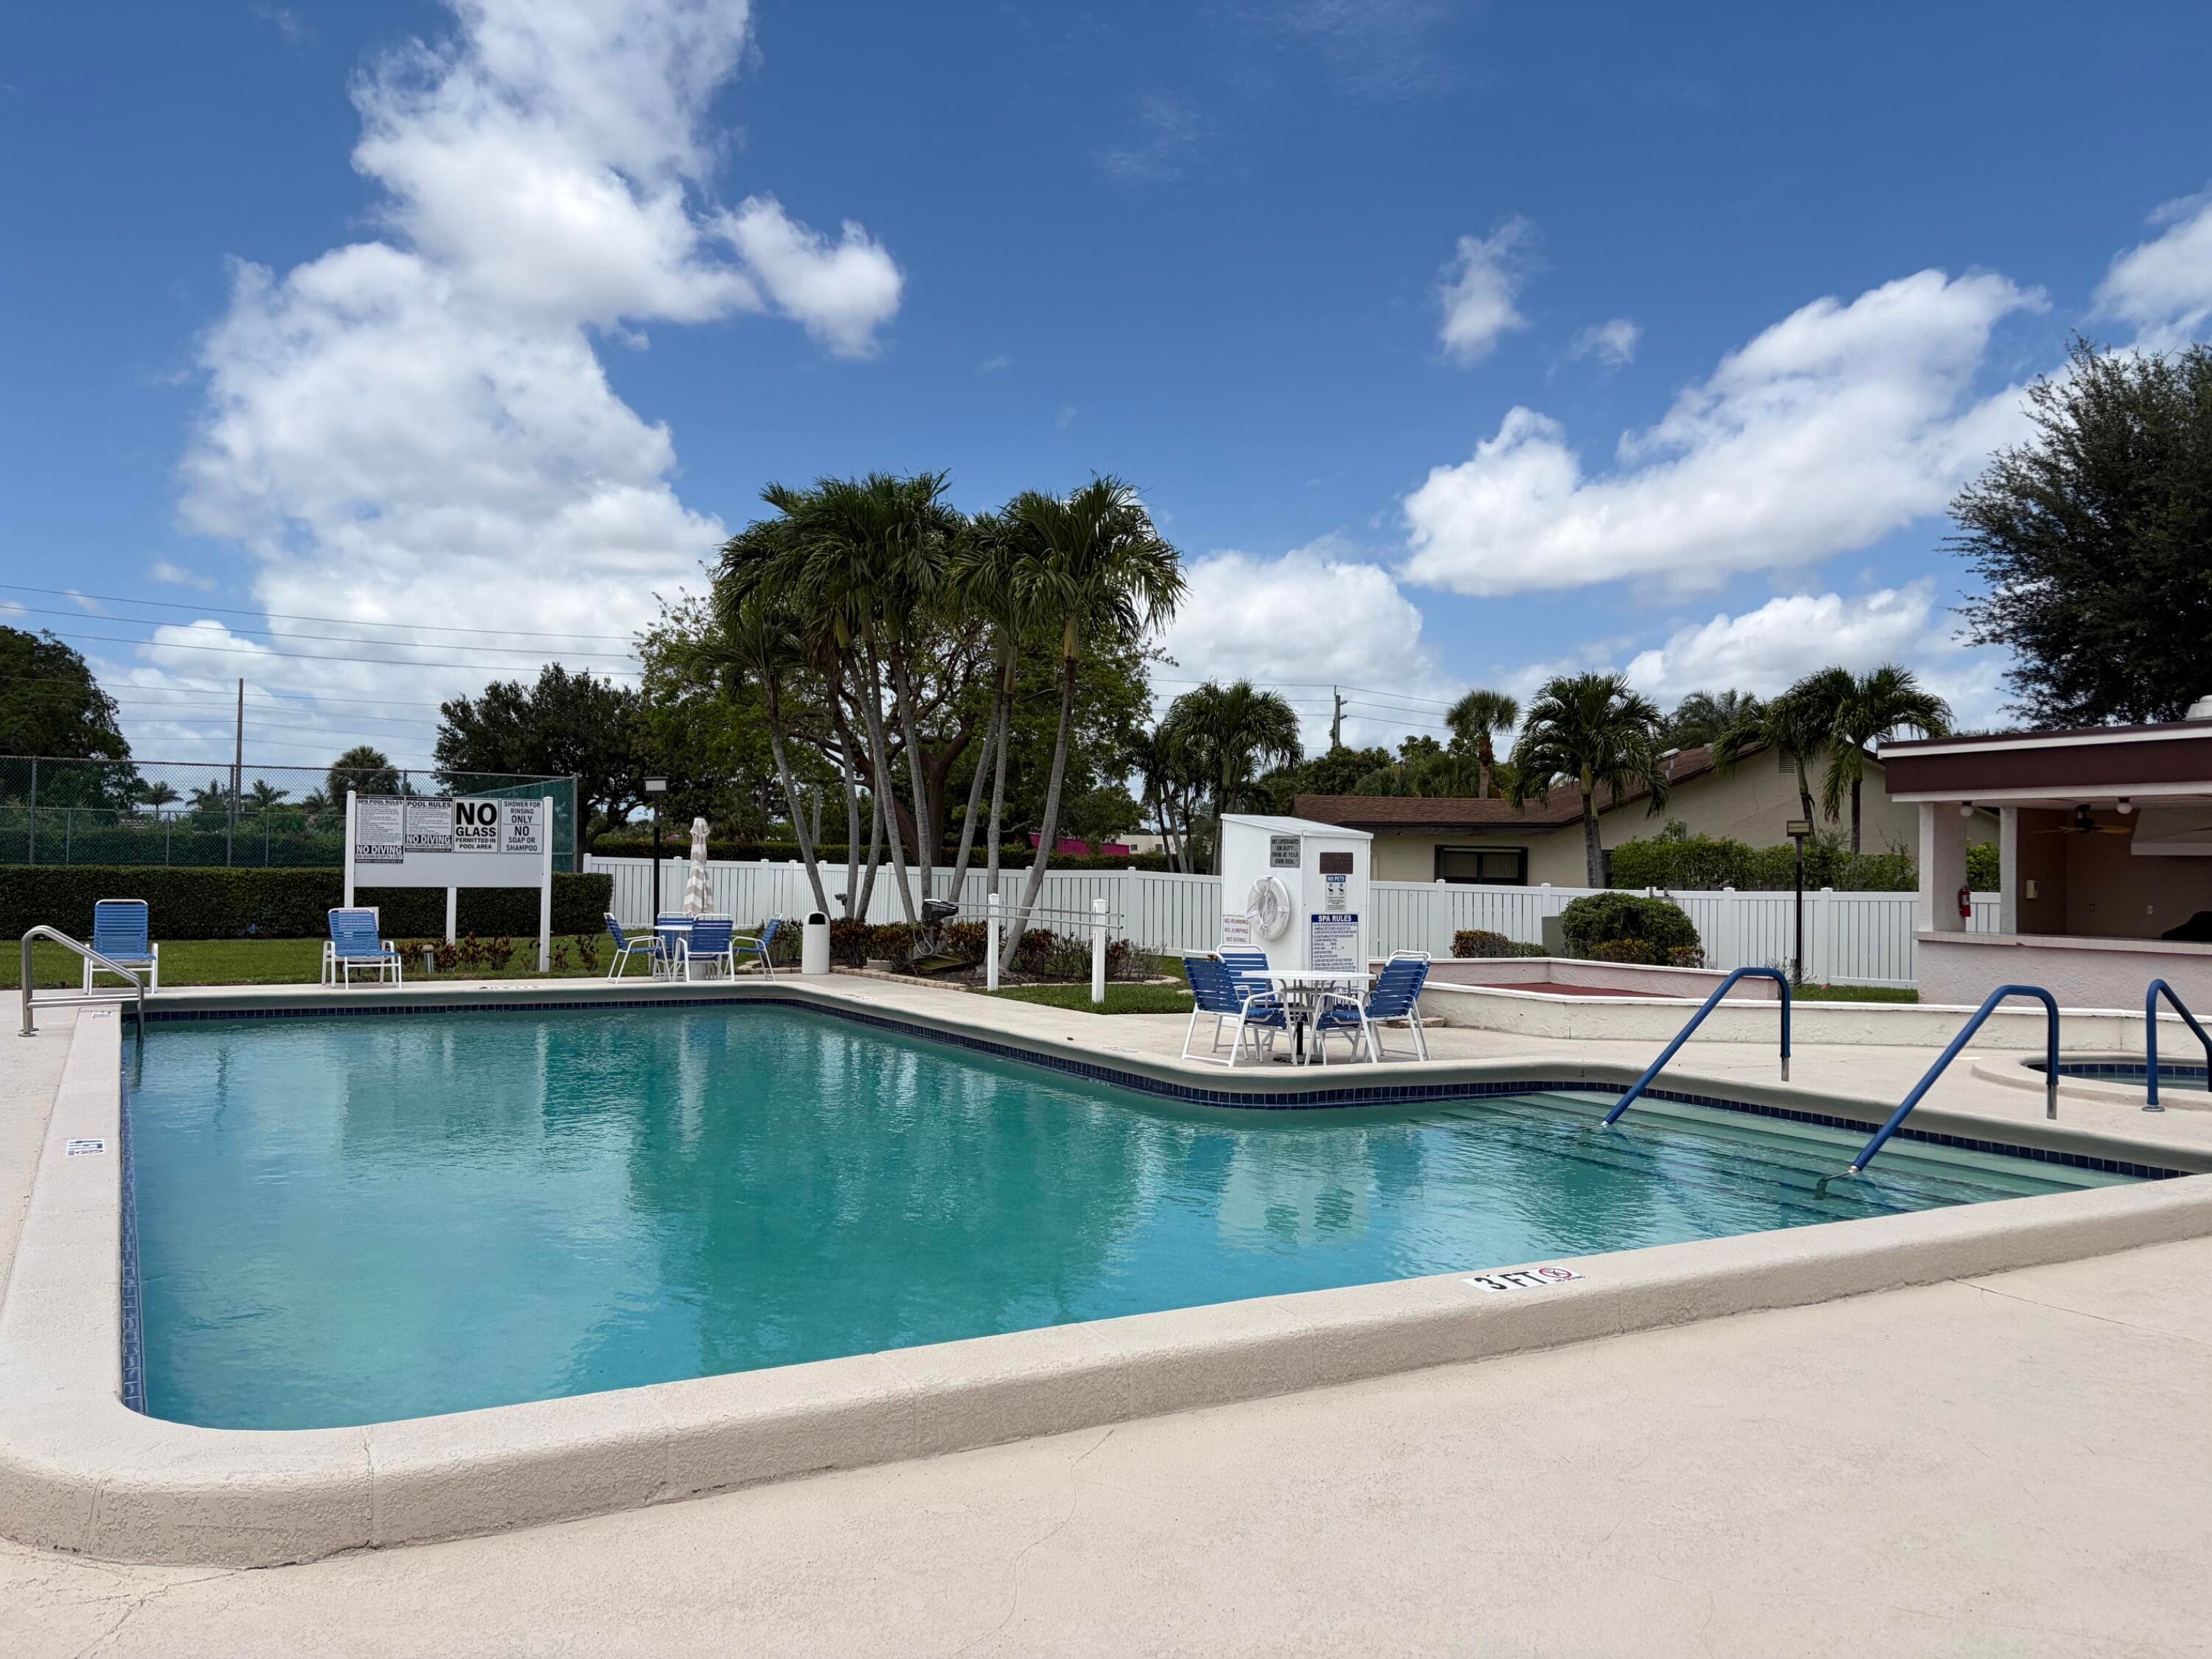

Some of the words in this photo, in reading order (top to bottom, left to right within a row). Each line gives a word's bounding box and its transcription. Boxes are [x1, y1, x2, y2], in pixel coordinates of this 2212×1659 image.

[456, 802, 498, 826] NO
[511, 815, 533, 824] ONLY
[456, 827, 496, 837] GLASS
[515, 826, 529, 836] NO
[406, 835, 420, 844] NO
[420, 835, 451, 844] DIVING
[356, 845, 369, 854] NO
[371, 846, 402, 855] DIVING
[1473, 1276, 1508, 1290] 3
[1498, 1271, 1548, 1287] FT
